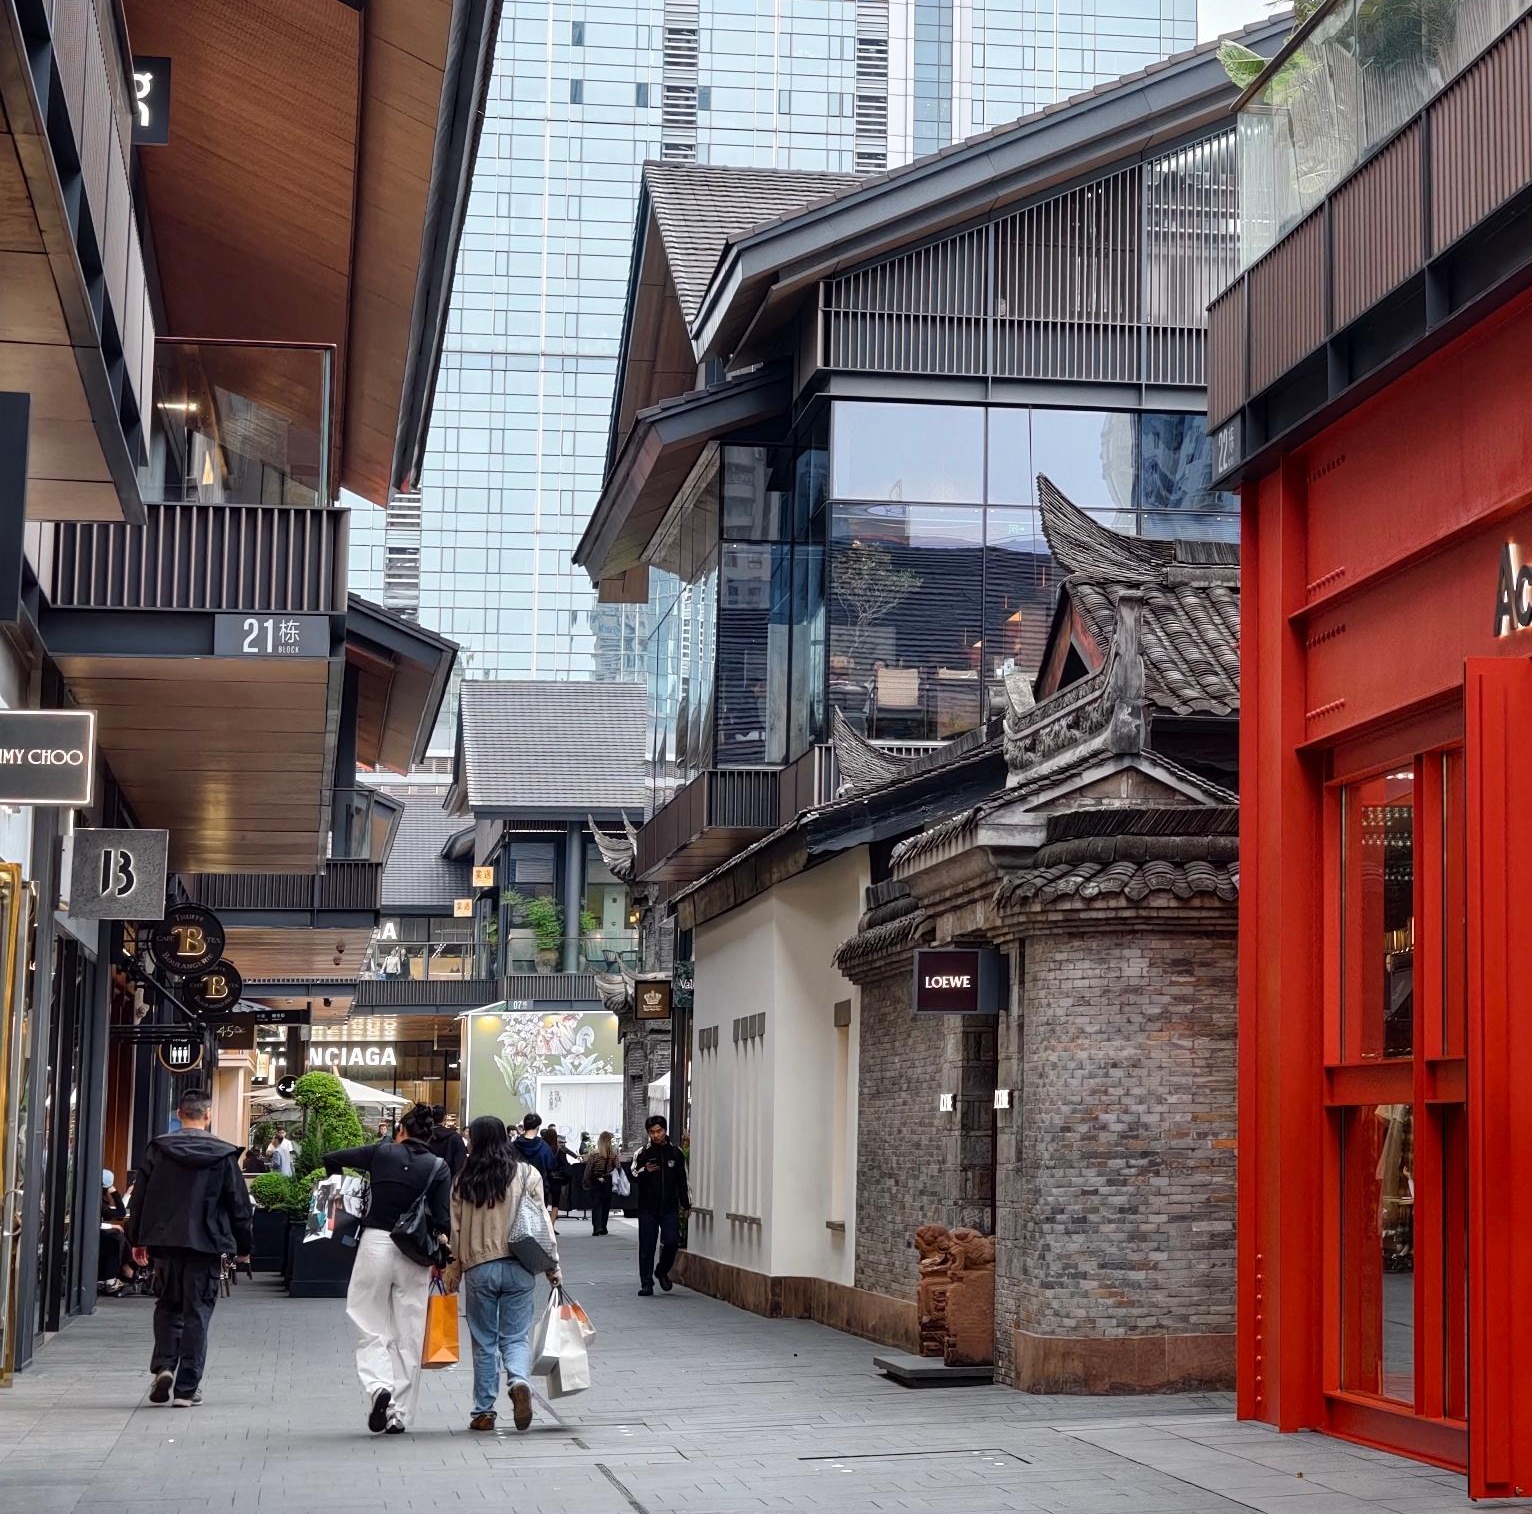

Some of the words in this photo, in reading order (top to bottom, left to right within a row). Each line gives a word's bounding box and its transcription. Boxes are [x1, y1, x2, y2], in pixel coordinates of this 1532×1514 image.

[243, 618, 300, 653] 21栋
[278, 645, 300, 654] BLOCK
[27, 749, 84, 766] CHOO
[679, 978, 695, 990] Val
[925, 975, 971, 989] LOEWE
[309, 1047, 397, 1066] NCIAGA
